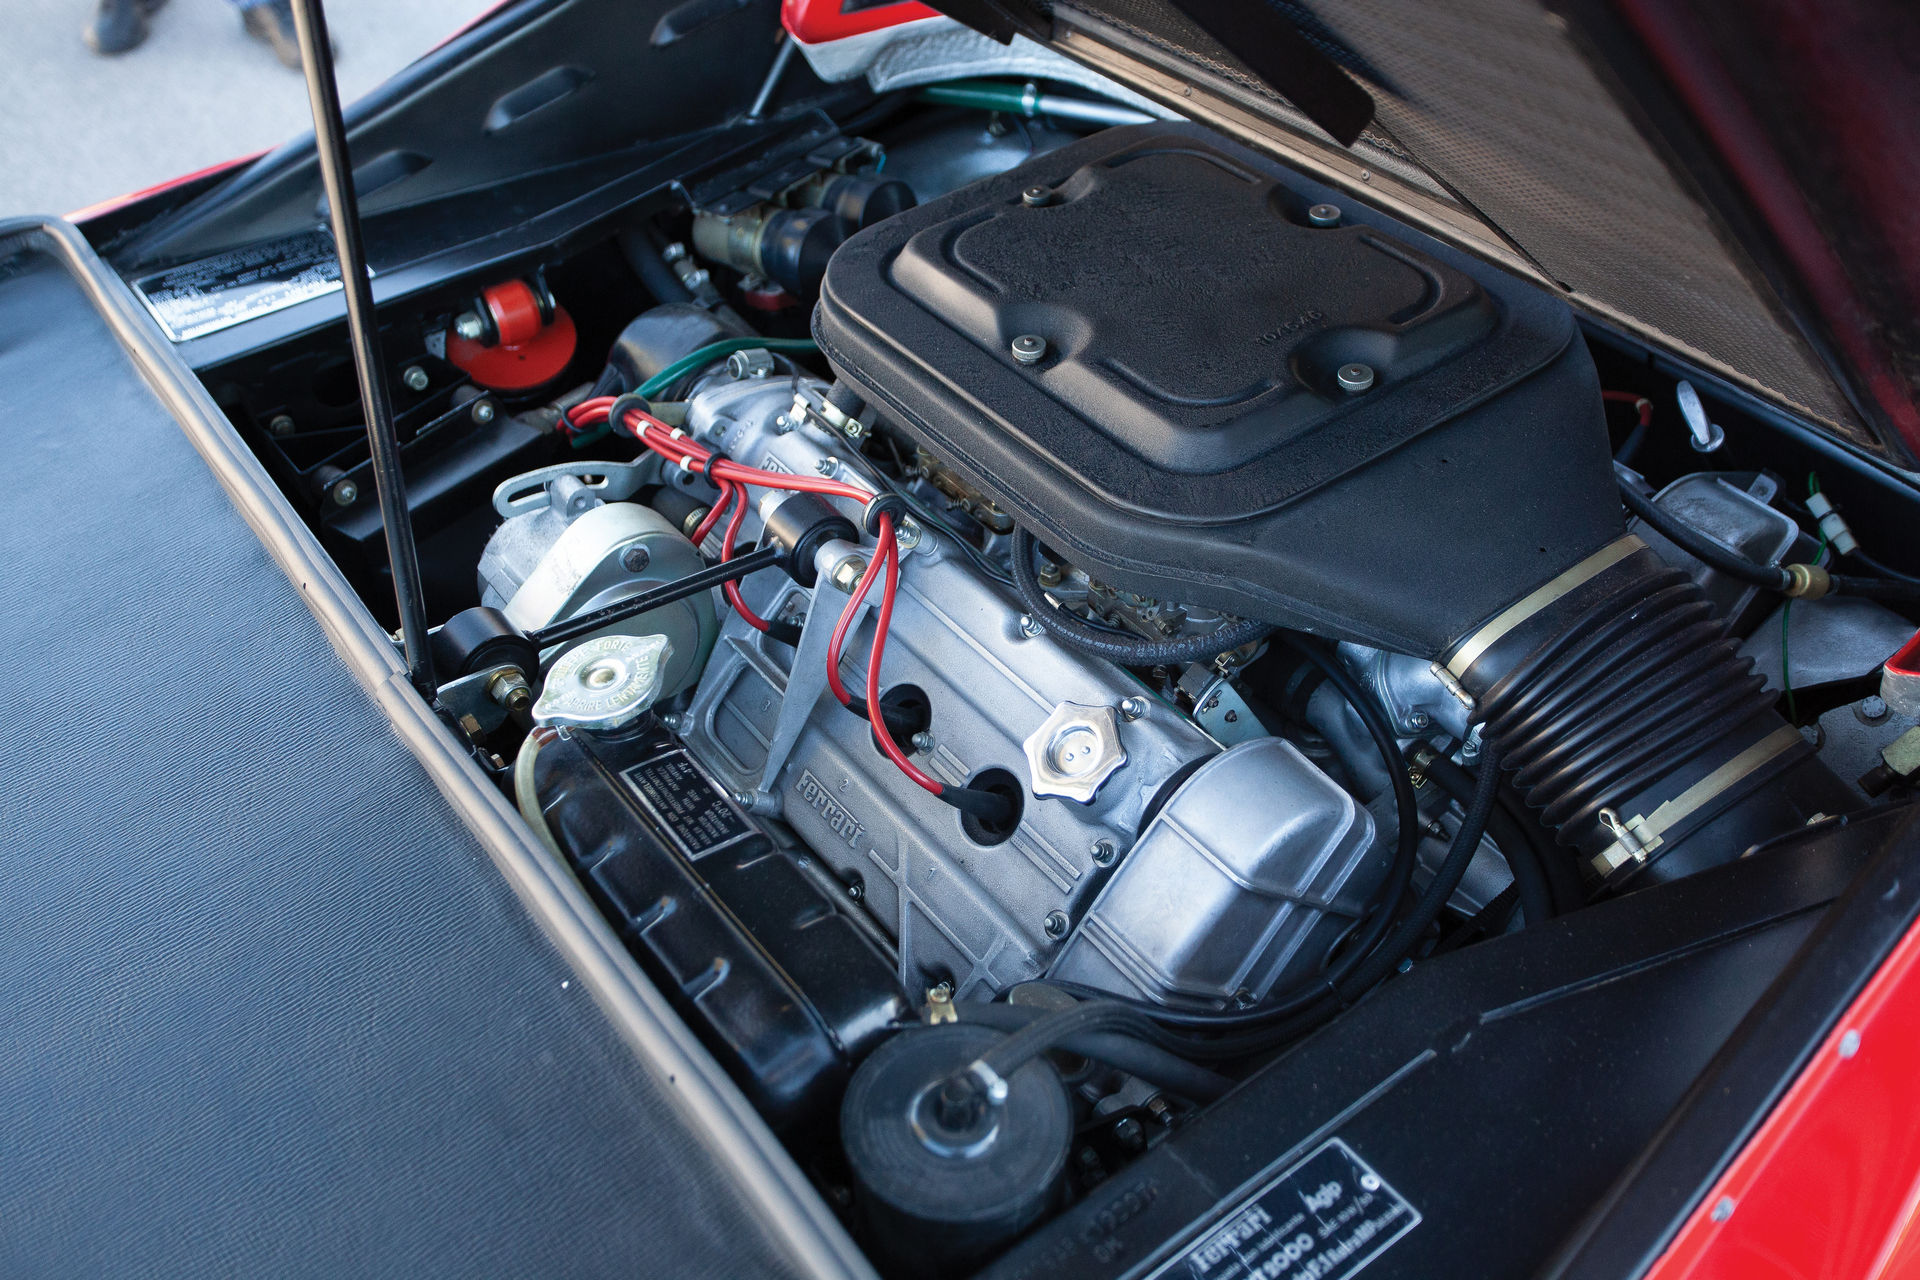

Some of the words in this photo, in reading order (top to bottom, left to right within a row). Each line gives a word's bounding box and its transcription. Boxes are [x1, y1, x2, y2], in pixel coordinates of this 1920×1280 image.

[606, 655, 649, 708] LENTAMENTE
[665, 811, 679, 822] CON
[685, 788, 702, 802] AVEC
[795, 769, 866, 849] Ferrari
[1300, 1176, 1347, 1216] Agip
[1186, 1203, 1274, 1273] Ferrari
[1259, 1230, 1318, 1278] 2000
